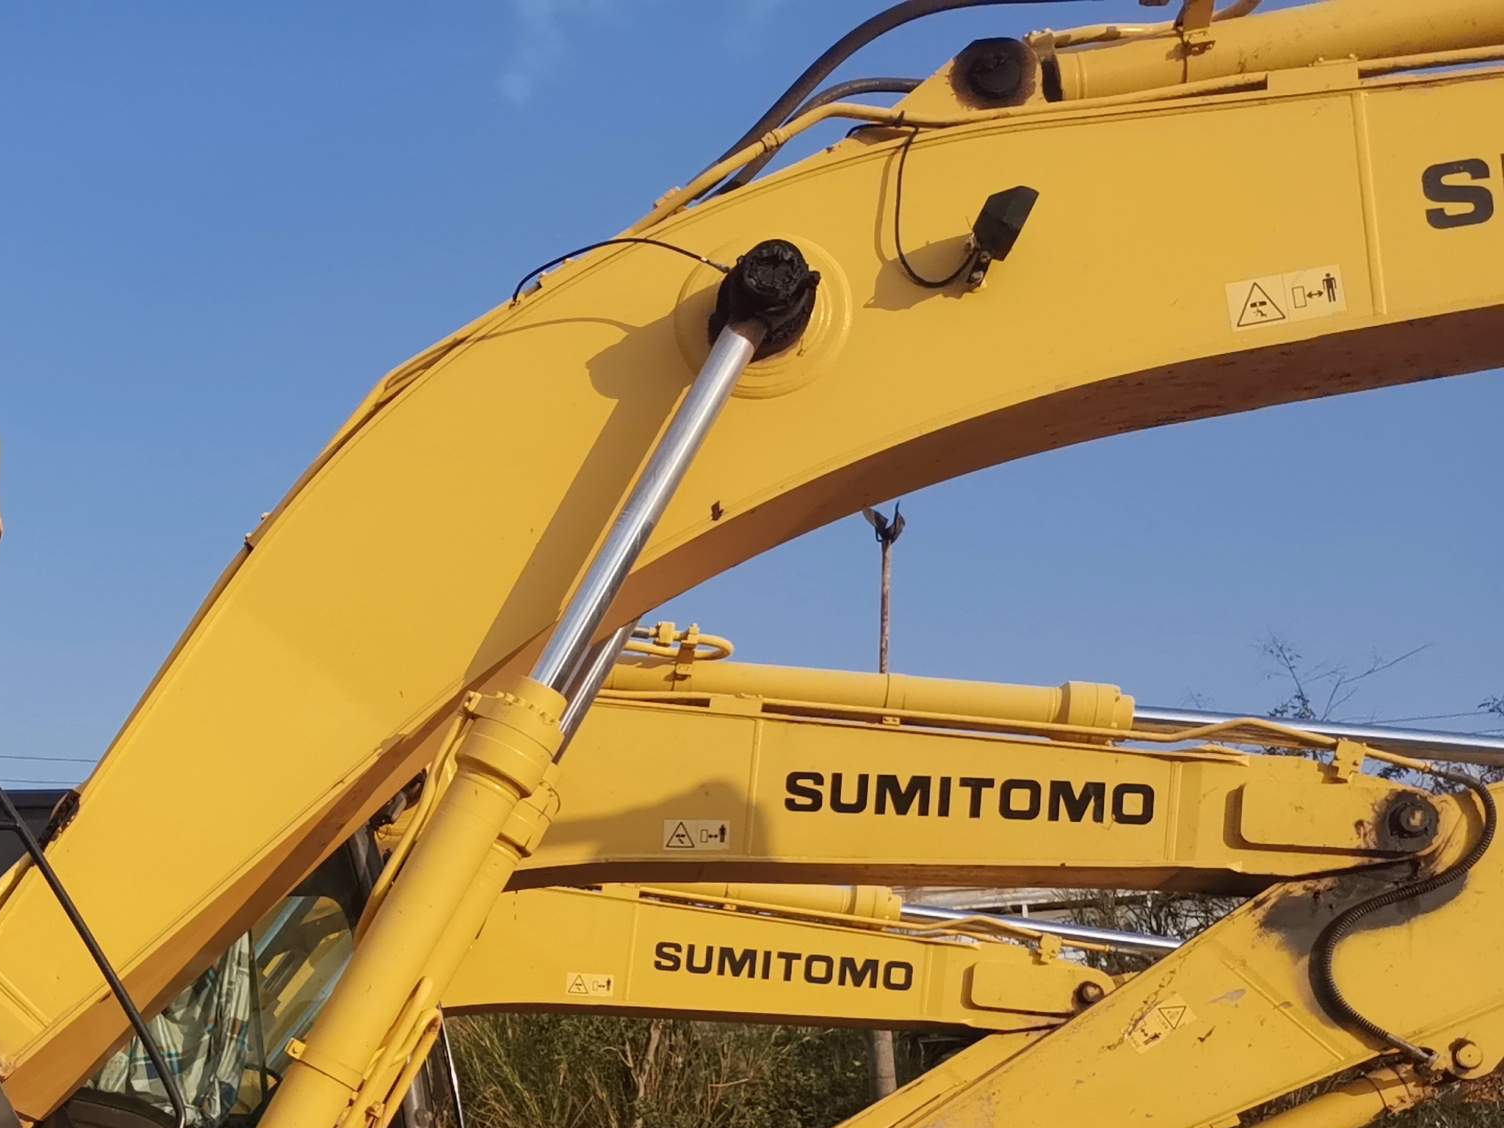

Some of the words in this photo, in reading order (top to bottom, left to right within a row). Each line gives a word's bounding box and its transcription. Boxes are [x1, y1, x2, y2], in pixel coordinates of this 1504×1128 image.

[1421, 153, 1504, 230] S
[785, 771, 1155, 825] SUMITOMO
[653, 941, 914, 992] SUMITOMO
